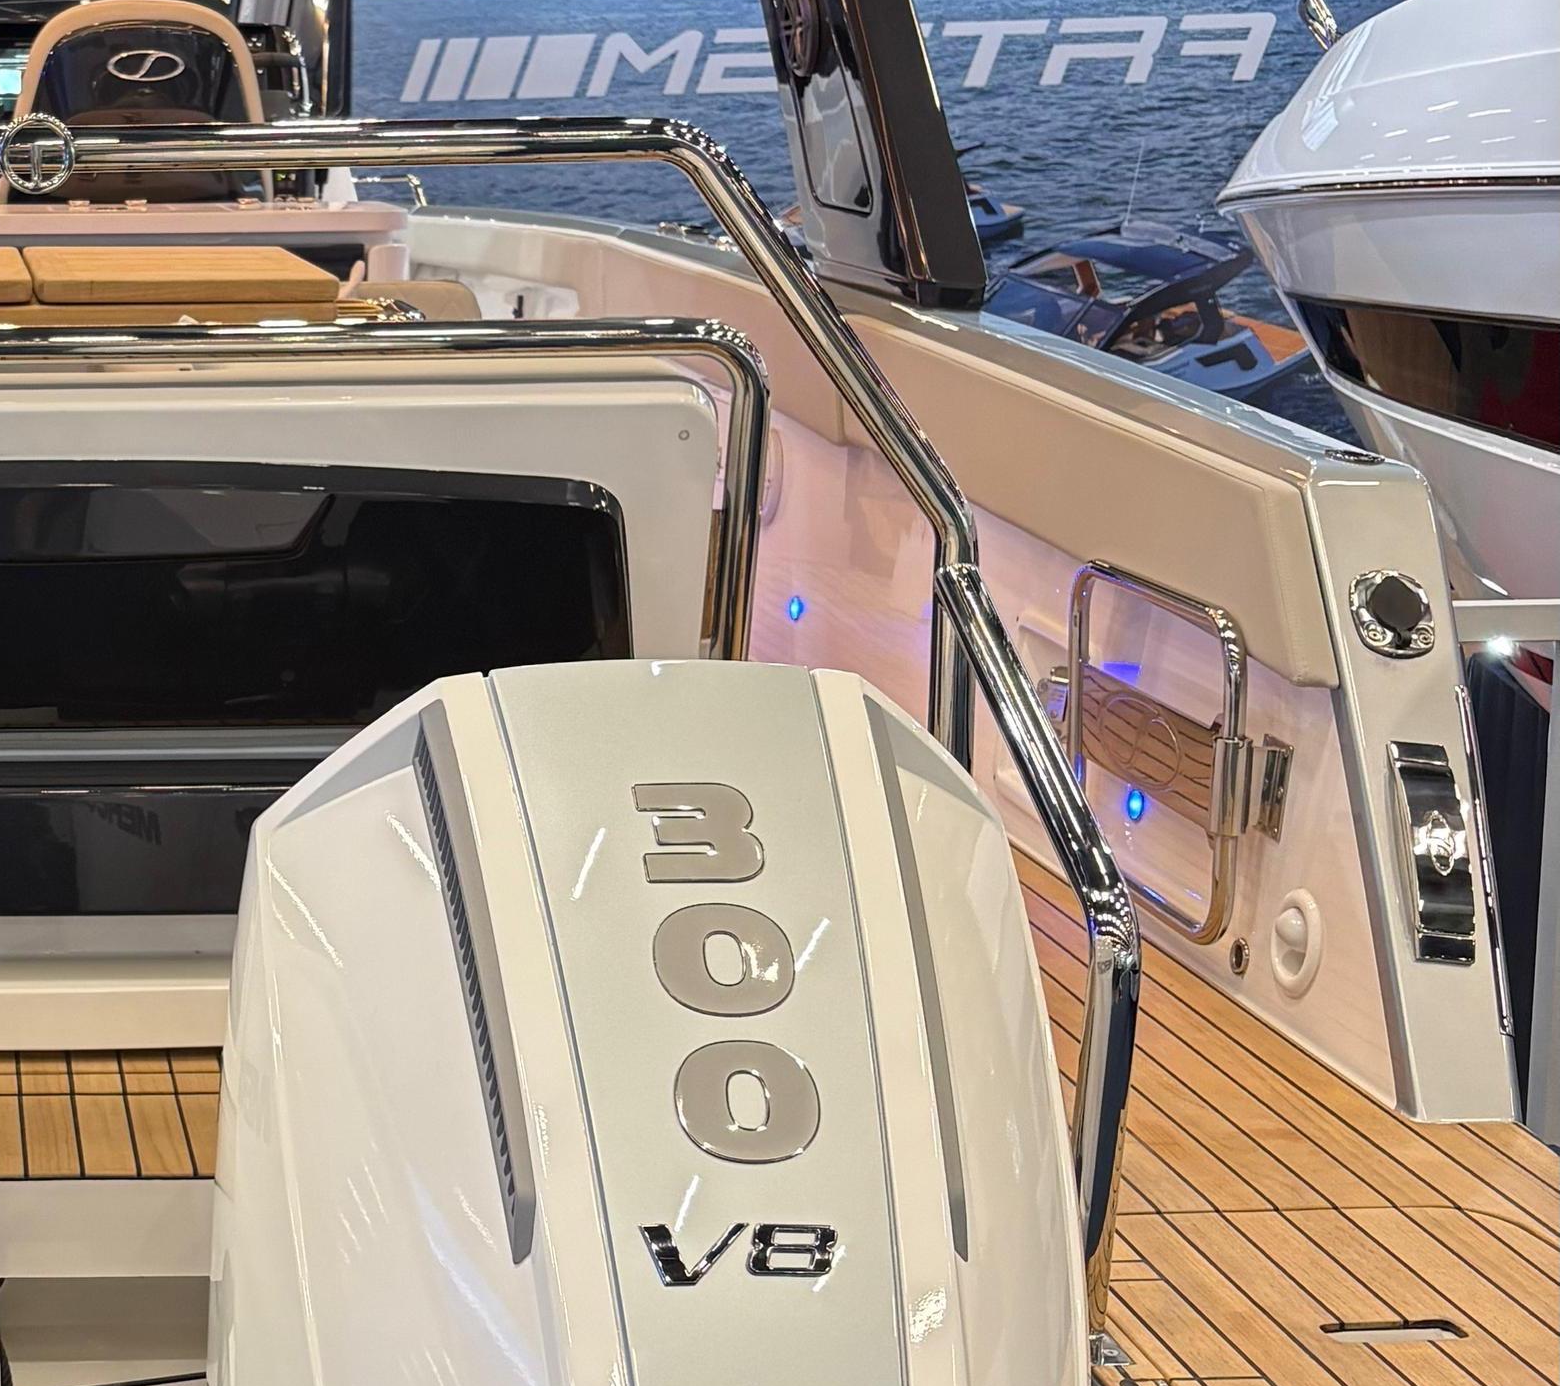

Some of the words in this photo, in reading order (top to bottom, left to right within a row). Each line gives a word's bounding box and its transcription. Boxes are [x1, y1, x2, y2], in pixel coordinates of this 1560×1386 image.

[585, 11, 1276, 97] METRA
[631, 781, 822, 1165] 300
[636, 1221, 841, 1288] V8
